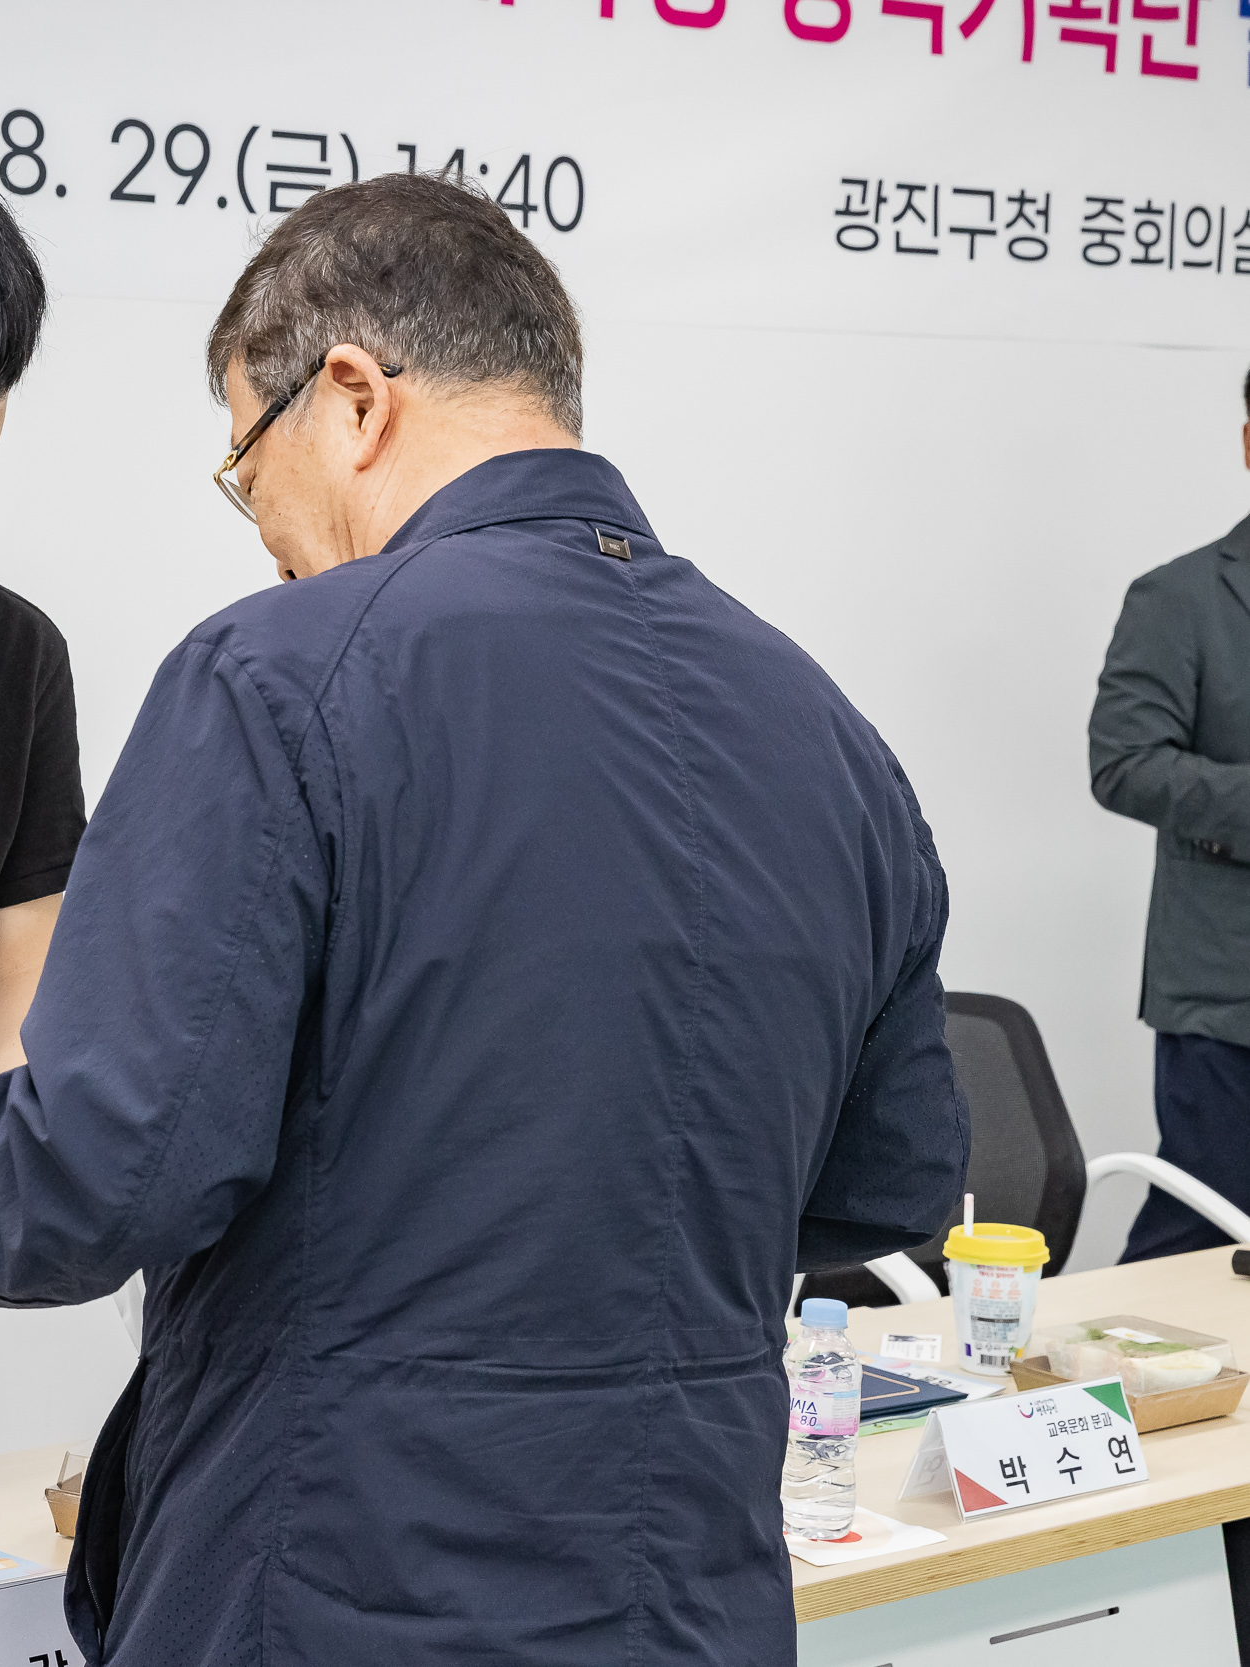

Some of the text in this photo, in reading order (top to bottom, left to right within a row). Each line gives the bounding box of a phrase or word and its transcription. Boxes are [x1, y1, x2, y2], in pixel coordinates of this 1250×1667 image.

[0, 109, 66, 198] 8.
[835, 177, 1052, 262] 광진구청
[800, 1415, 817, 1427] 8.0
[1047, 1412, 1112, 1438] 교육문화 분과
